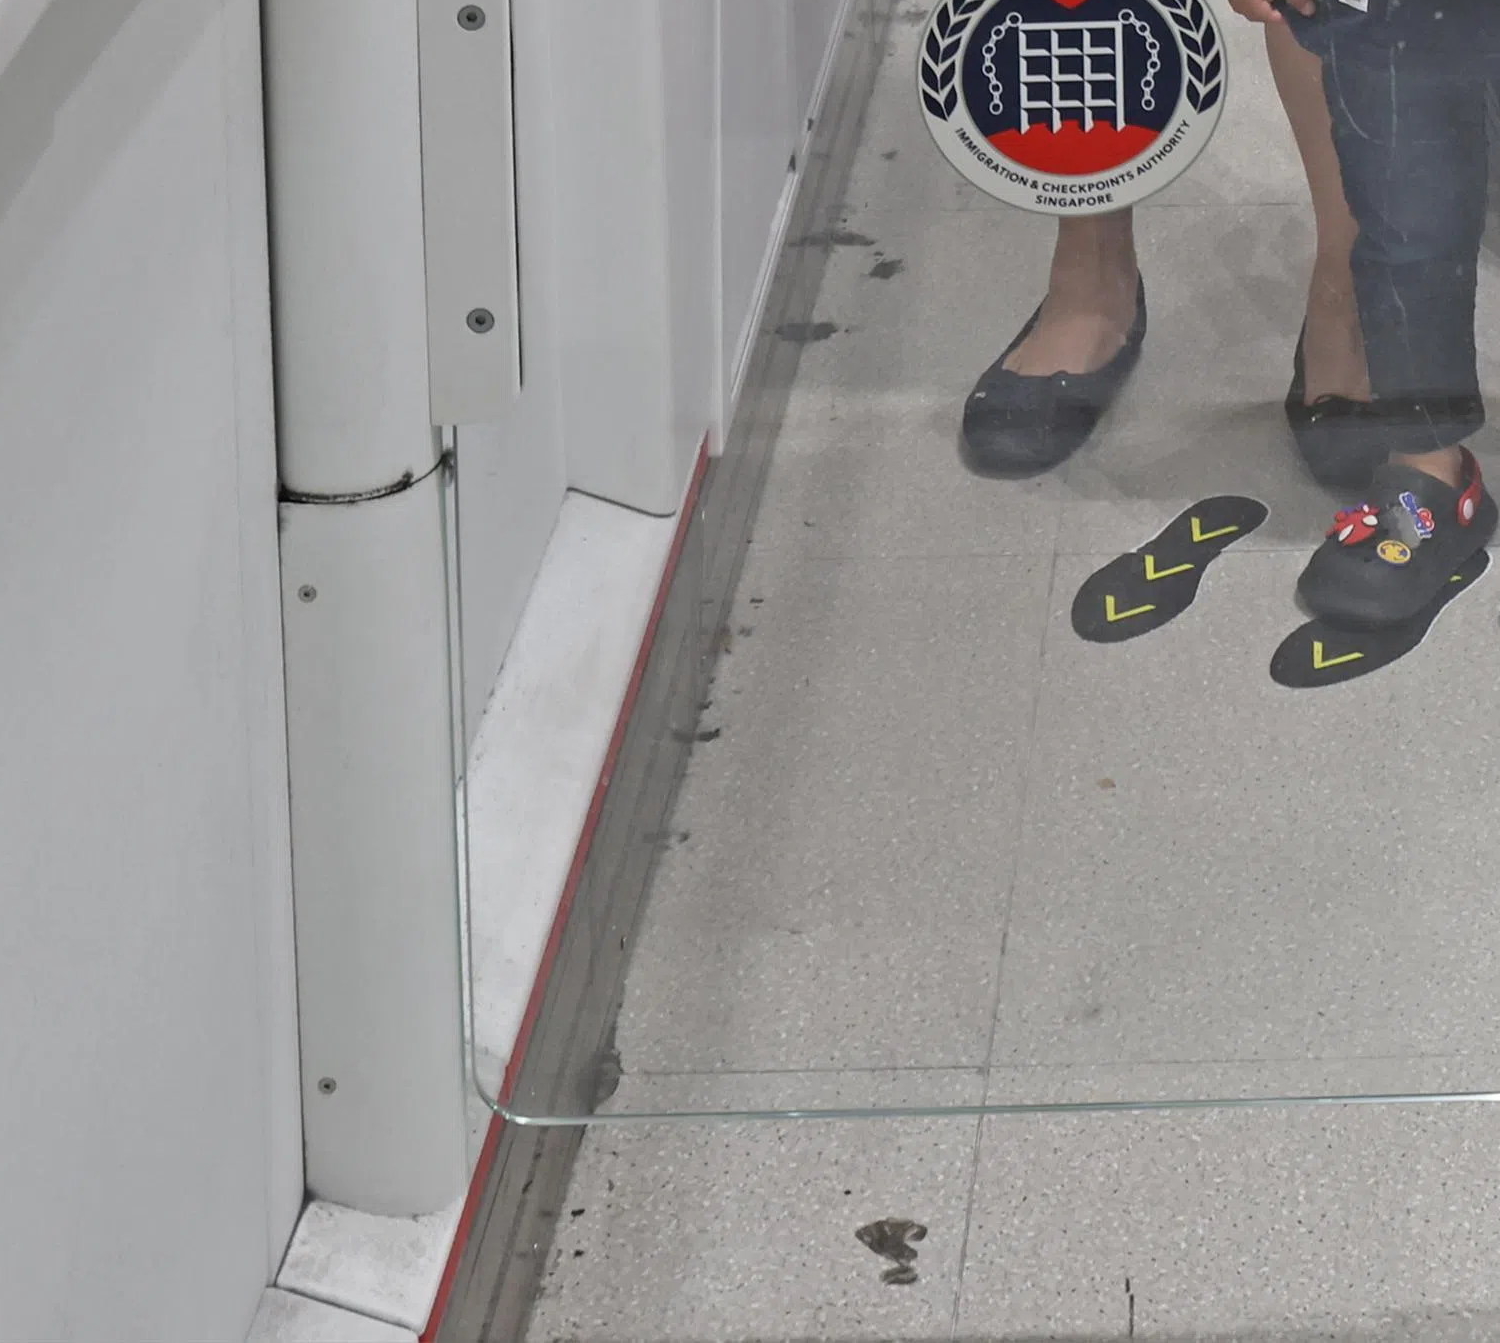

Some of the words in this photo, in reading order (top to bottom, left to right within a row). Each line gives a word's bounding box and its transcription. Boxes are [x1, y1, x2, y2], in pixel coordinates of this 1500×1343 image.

[954, 127, 1030, 188] IMMIGRATION
[1029, 178, 1039, 190] &
[1042, 172, 1136, 195] CHECKPOINTS
[1135, 119, 1191, 177] AUTHORITY
[1034, 193, 1115, 207] SINGAPORE
